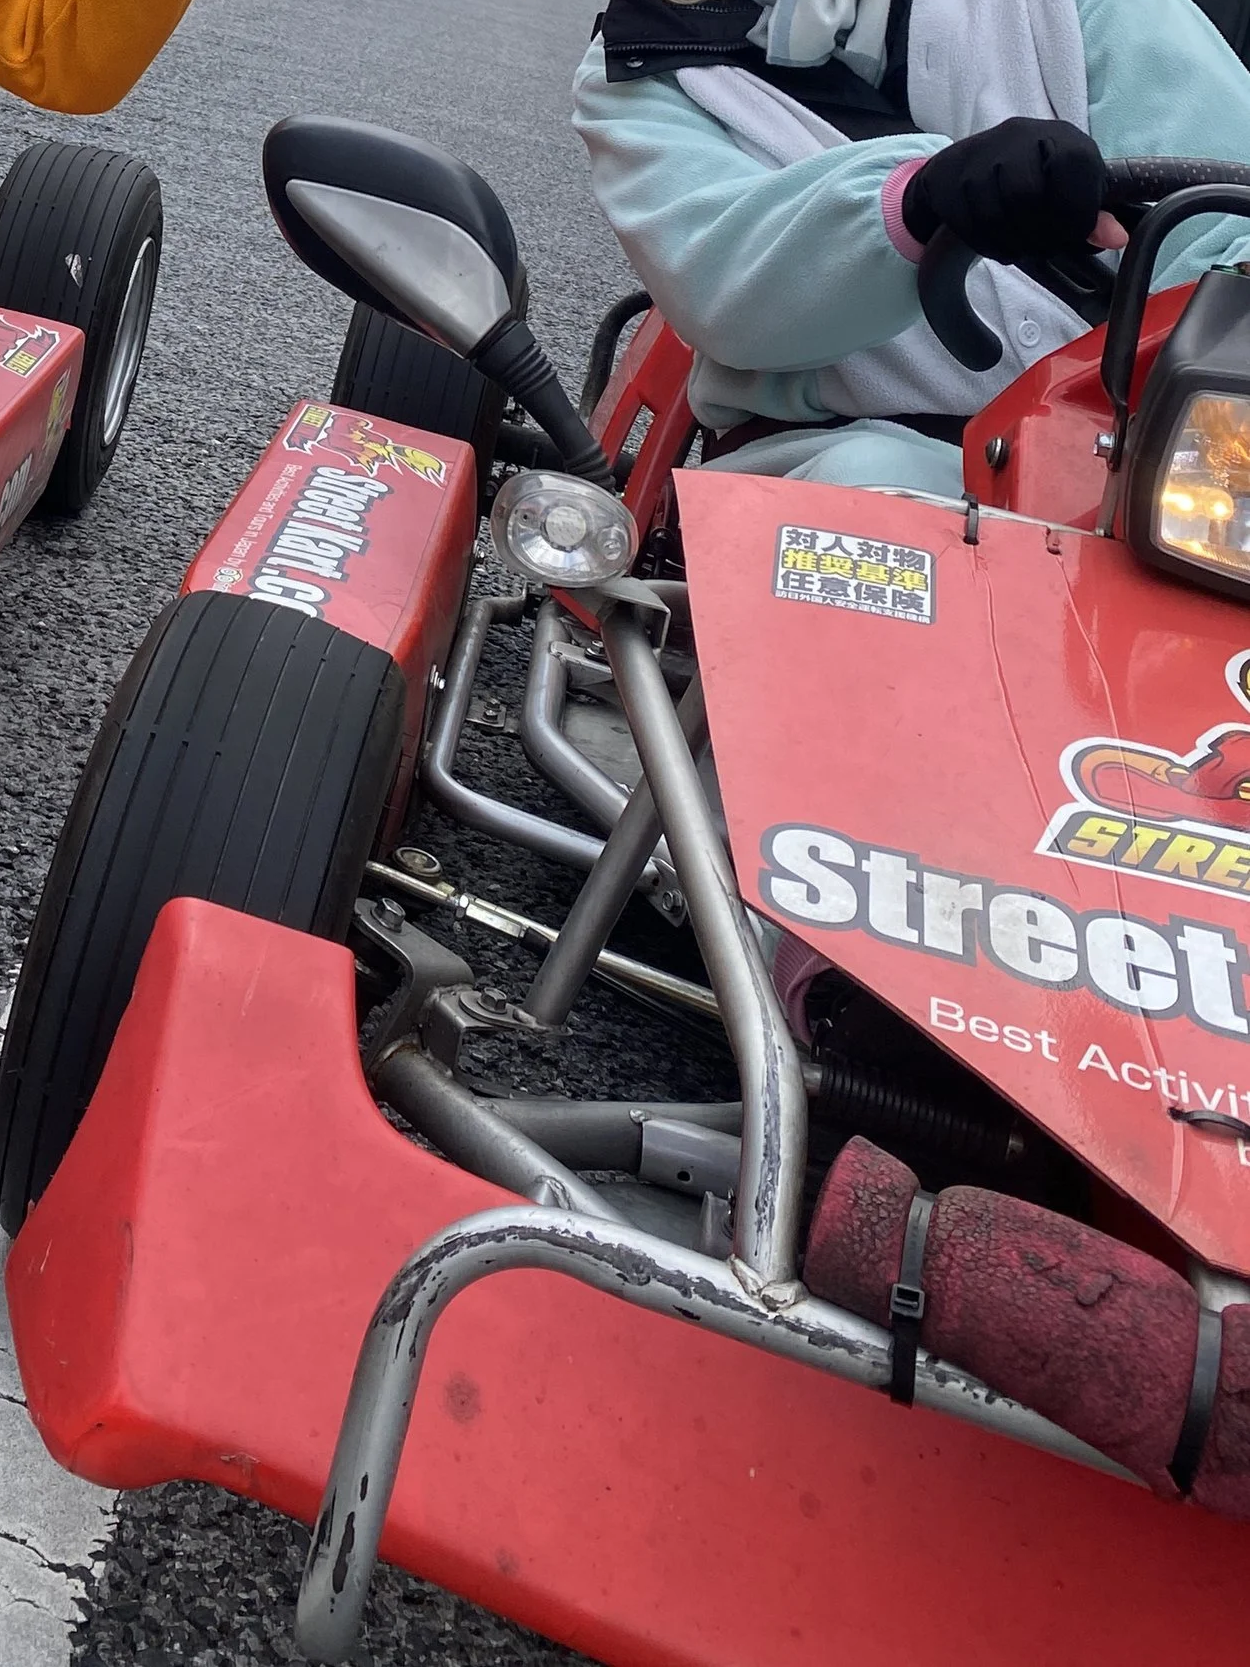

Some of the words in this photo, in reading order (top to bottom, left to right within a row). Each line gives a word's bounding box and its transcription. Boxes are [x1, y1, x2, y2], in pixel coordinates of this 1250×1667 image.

[292, 466, 389, 533] Street
[782, 547, 929, 592] 推奨基準
[785, 528, 926, 571] 対人対物
[780, 570, 926, 613] 任意保険
[1067, 815, 1250, 893] STRE
[767, 825, 1250, 1036] Street
[929, 995, 1060, 1063] Best
